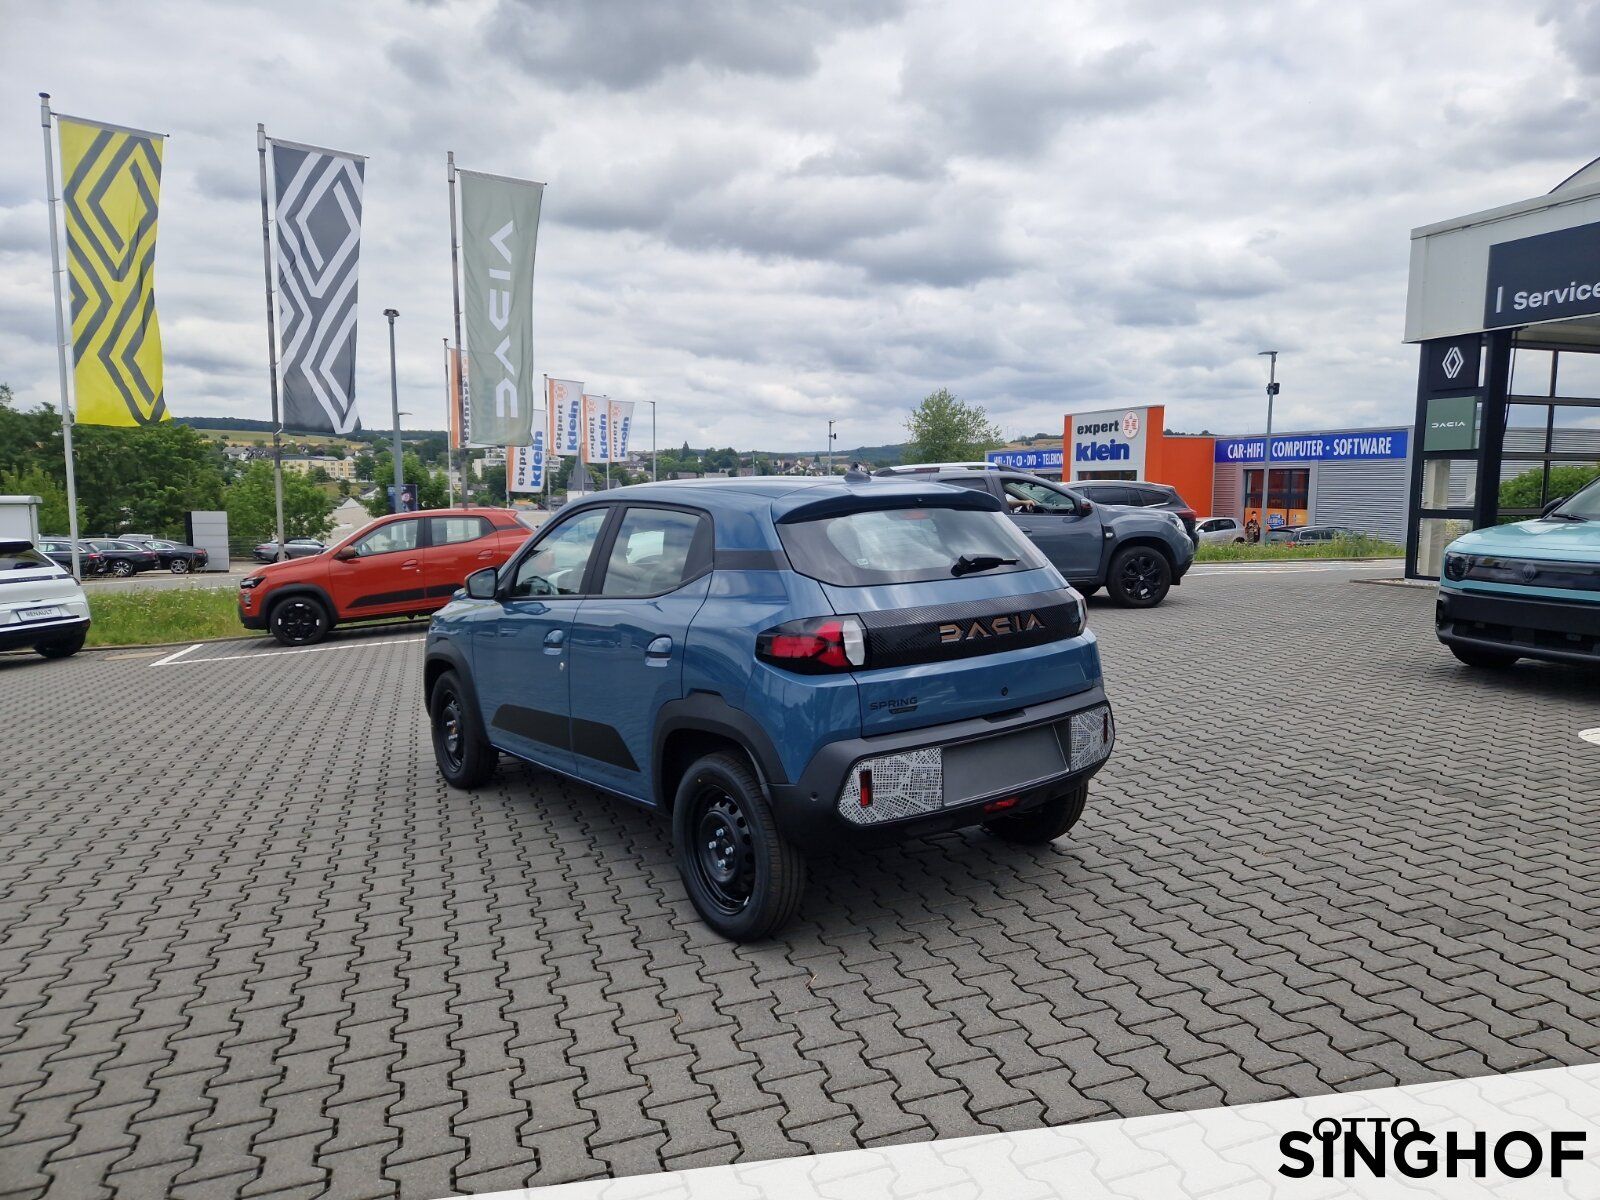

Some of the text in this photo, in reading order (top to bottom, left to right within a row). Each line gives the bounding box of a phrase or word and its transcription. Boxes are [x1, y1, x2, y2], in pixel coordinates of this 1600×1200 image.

[1513, 281, 1600, 311] Service
[488, 219, 519, 418] DACIA
[555, 403, 564, 450] expert
[567, 400, 579, 450] klein
[1077, 420, 1119, 435] expert
[530, 430, 543, 487] klein
[1076, 438, 1130, 461] klein
[1271, 439, 1323, 458] COMPUTER
[1333, 436, 1392, 456] SOFTWARE
[517, 447, 527, 486] expe
[938, 613, 1046, 643] DACIA
[870, 696, 918, 710] SPRING
